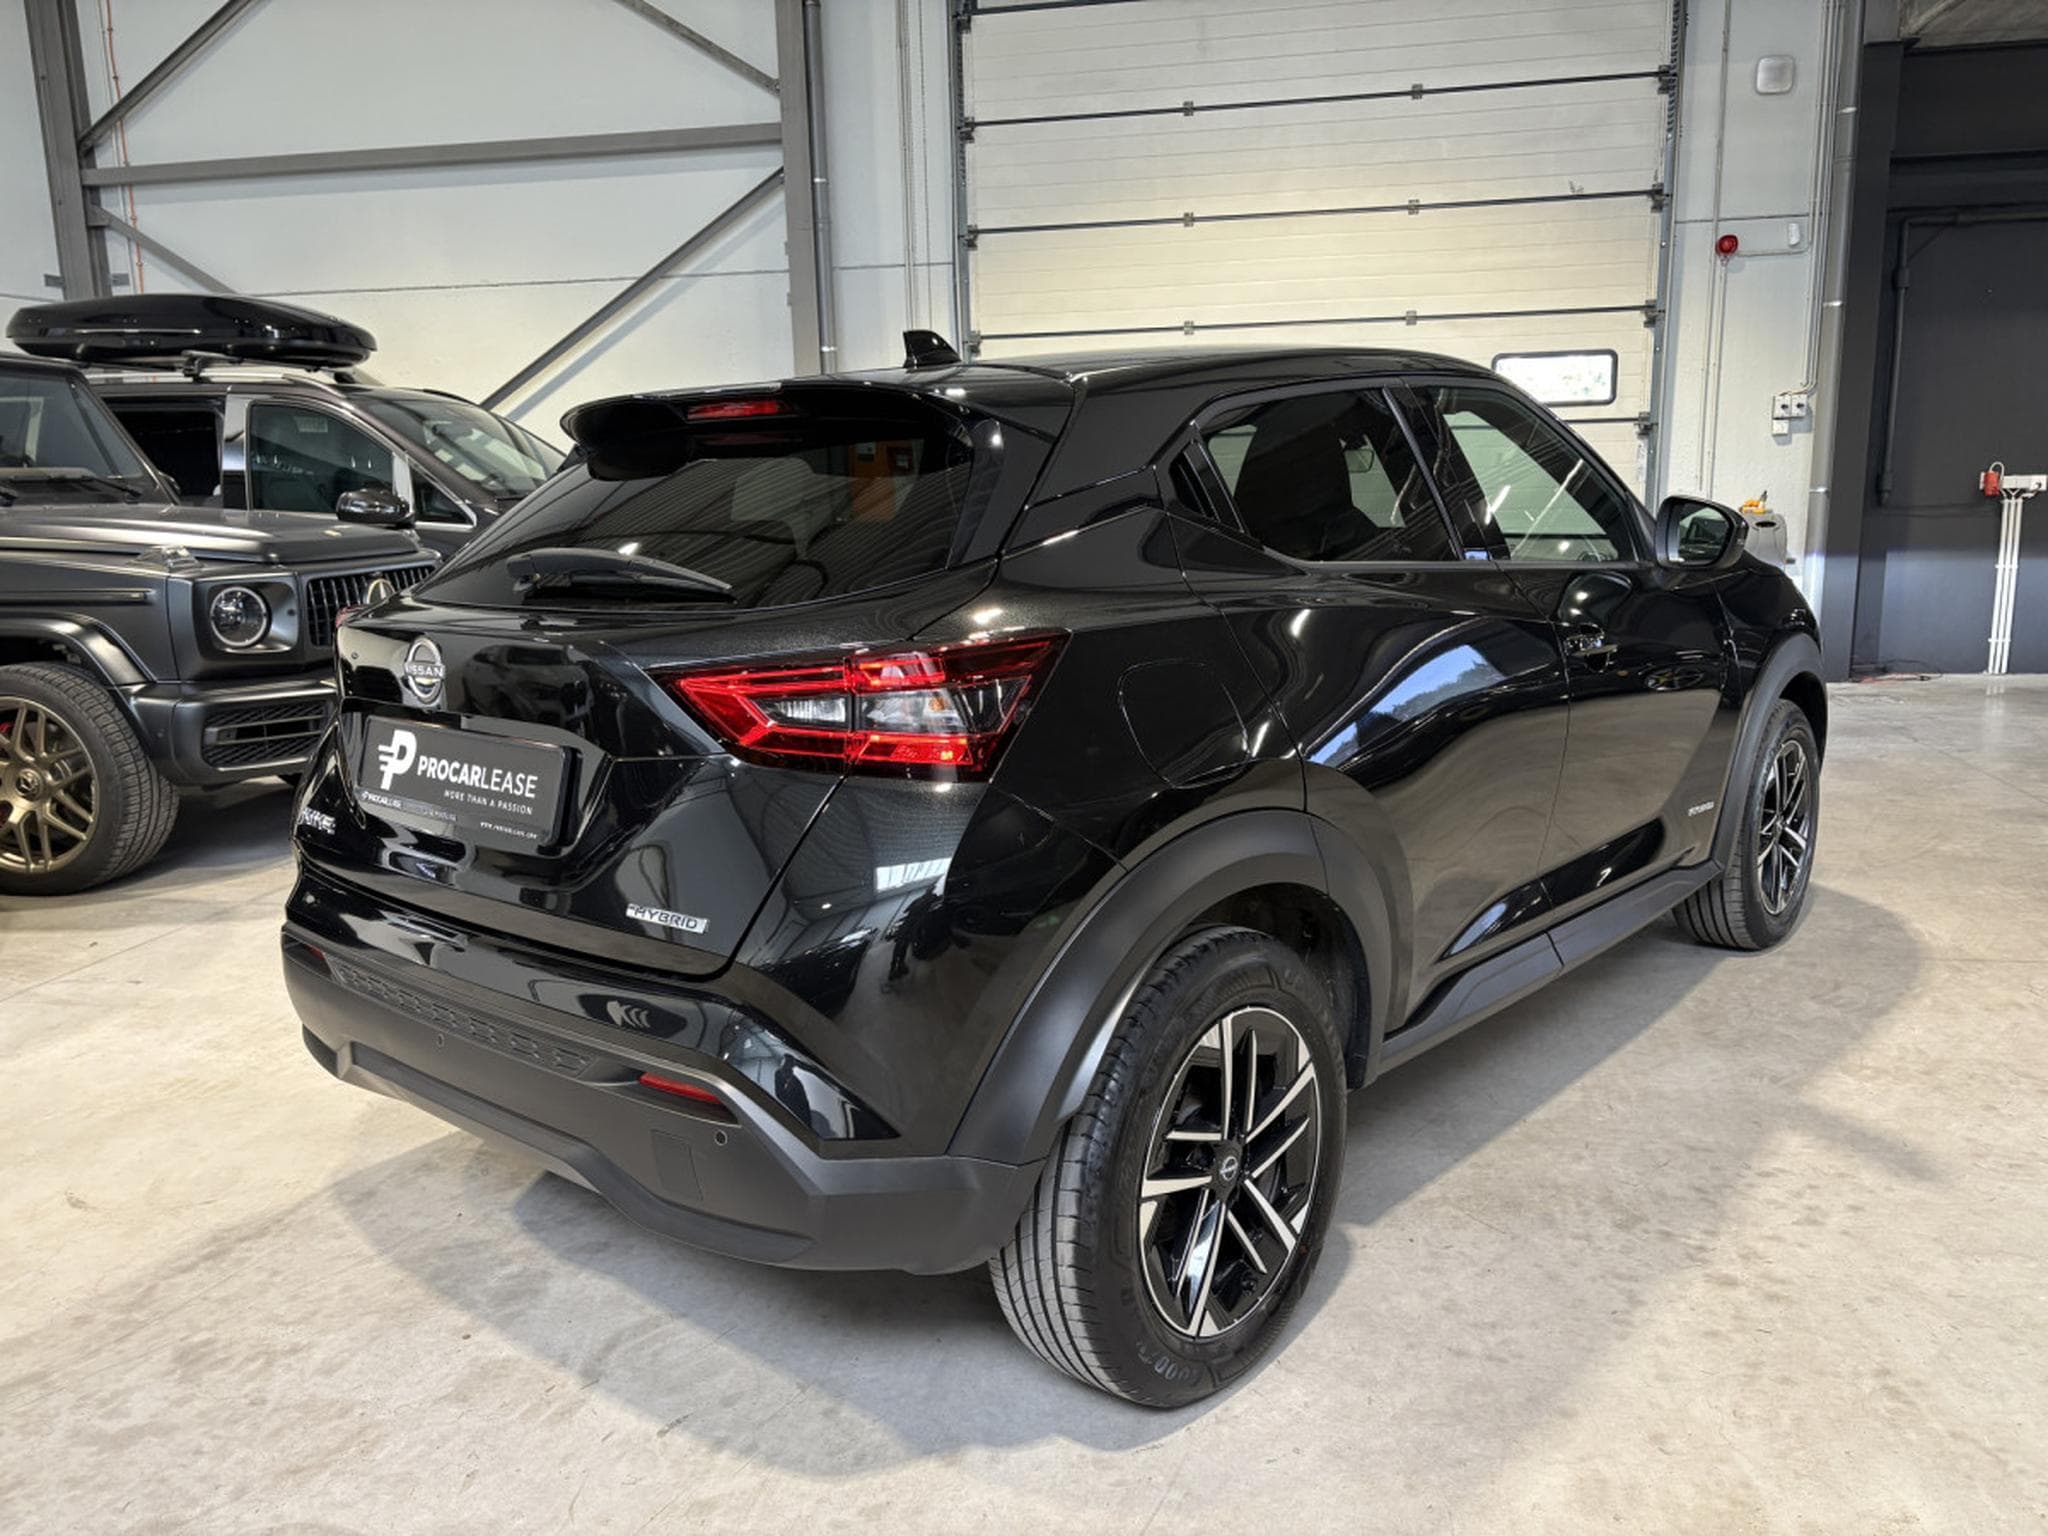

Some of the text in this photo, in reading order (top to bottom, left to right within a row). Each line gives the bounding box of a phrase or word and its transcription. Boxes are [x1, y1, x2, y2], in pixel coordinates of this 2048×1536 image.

[417, 755, 538, 798] PROCARLEASE
[444, 789, 533, 815] MORE THAN A PASSION
[633, 907, 698, 929] HYBRID
